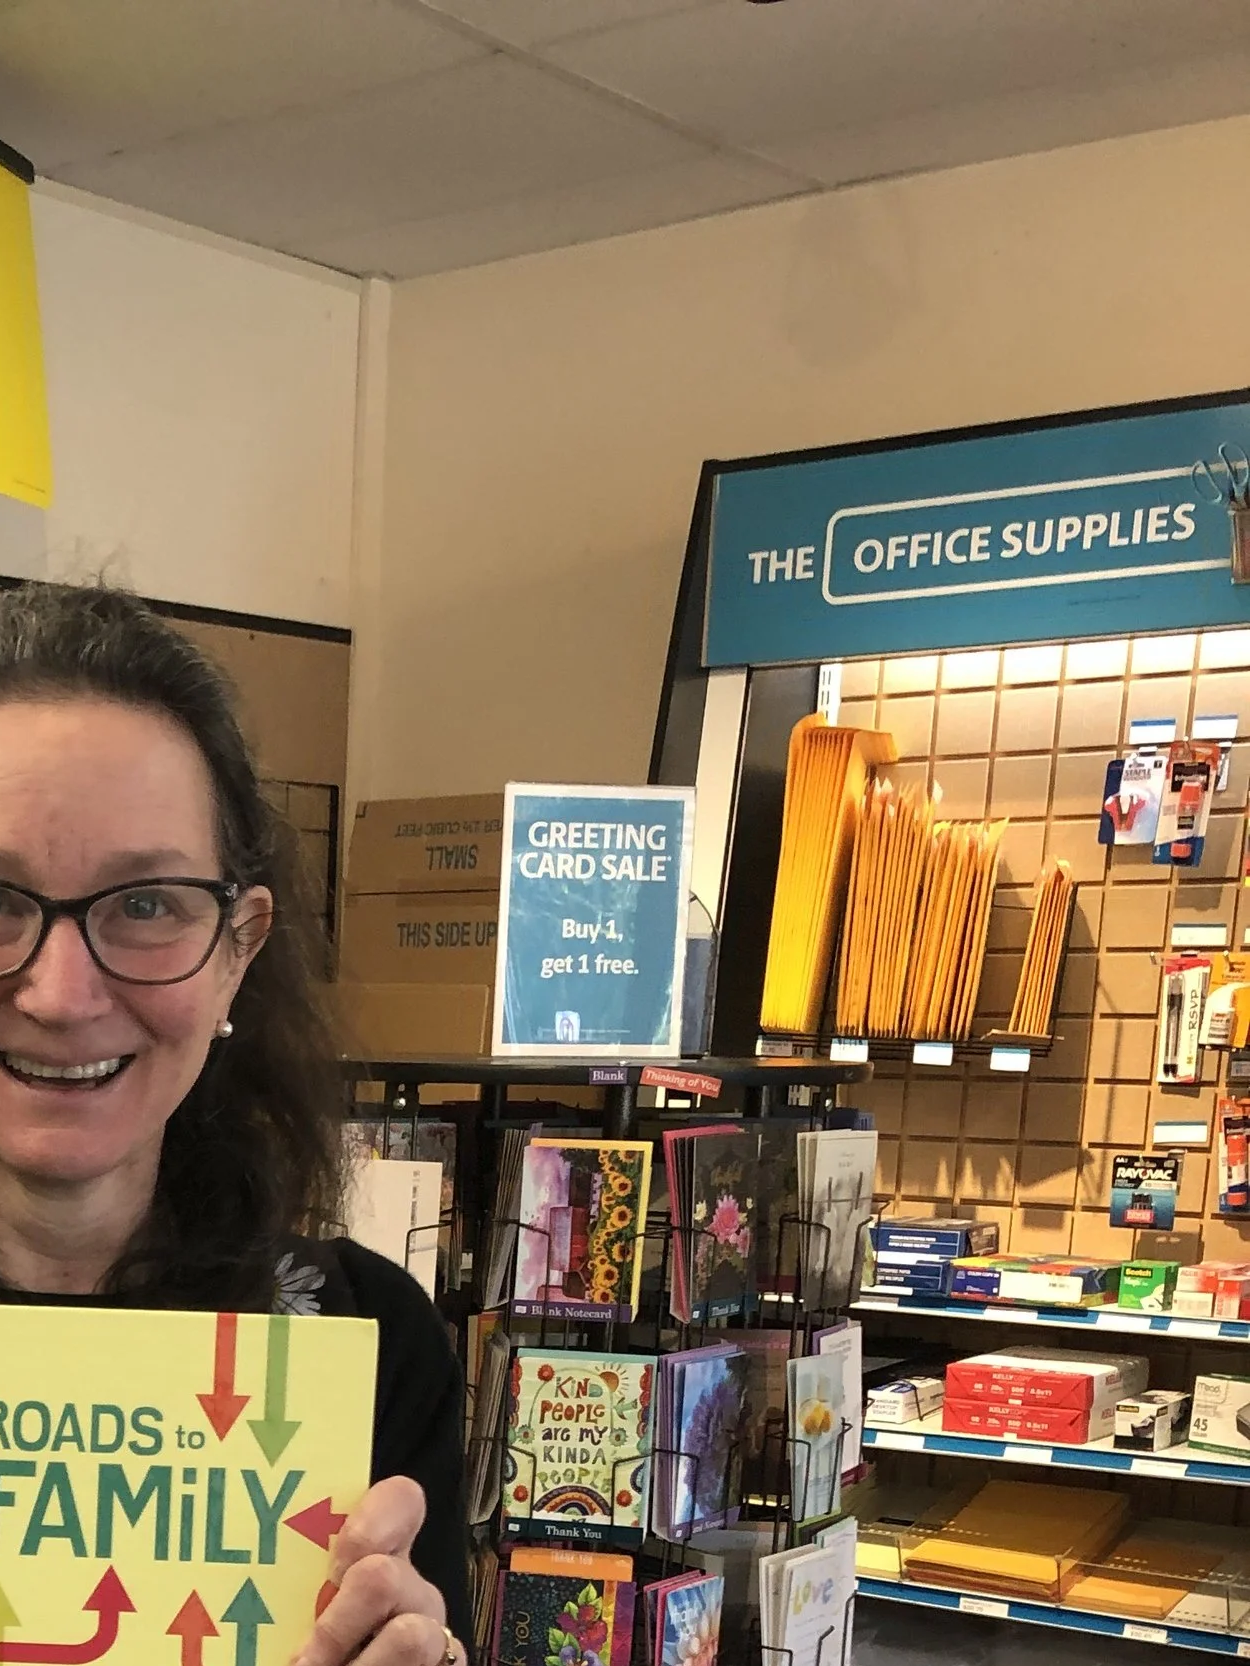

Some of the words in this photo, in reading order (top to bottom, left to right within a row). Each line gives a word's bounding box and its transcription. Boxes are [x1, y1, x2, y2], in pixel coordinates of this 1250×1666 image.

[748, 545, 815, 584] THE
[853, 526, 992, 574] OFFICE
[1000, 502, 1196, 559] SUPPLIES
[394, 823, 422, 837] FEET
[425, 821, 459, 836] CUBIC
[528, 821, 667, 851] GREETING
[426, 845, 478, 871] SMALL
[519, 852, 596, 882] CARD
[397, 923, 430, 948] THIS
[435, 922, 471, 947] SIDE
[475, 924, 496, 947] UP
[562, 918, 600, 943] Buy
[606, 920, 623, 943] 1,
[541, 956, 573, 978] get
[578, 954, 589, 974] 1
[594, 954, 639, 975] free.
[1189, 989, 1200, 1030] RSVP
[593, 1071, 624, 1081] Blank
[646, 1070, 686, 1087] Thinking
[688, 1078, 699, 1087] of
[701, 1080, 719, 1091] You
[1116, 1167, 1172, 1180] RAYOVAC
[1125, 1268, 1151, 1277] Scotch
[531, 1306, 562, 1317] Blnk
[565, 1308, 612, 1320] Notecard
[1193, 1418, 1208, 1431] 45
[175, 1424, 206, 1450] to
[543, 1446, 607, 1465] KINDA
[545, 1525, 580, 1537] Thank
[582, 1528, 602, 1539] You
[515, 1611, 531, 1649] YOU
